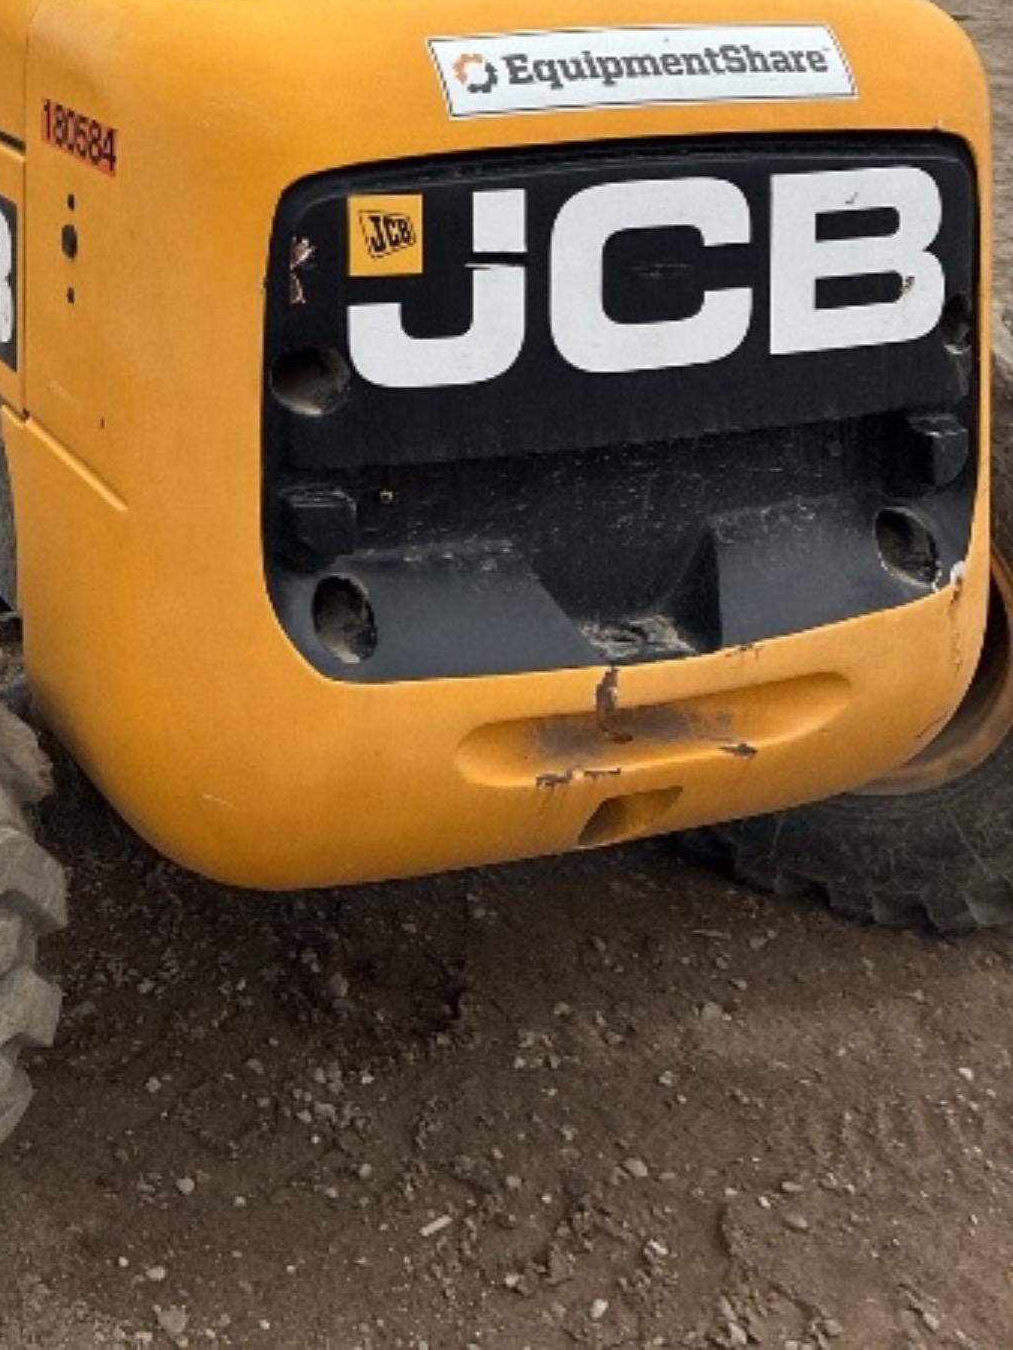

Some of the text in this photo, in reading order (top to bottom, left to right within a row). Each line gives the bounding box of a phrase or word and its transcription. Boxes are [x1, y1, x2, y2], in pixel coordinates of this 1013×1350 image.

[502, 44, 829, 90] EquipmentShare
[368, 215, 412, 252] JCB
[348, 166, 945, 388] JCB
